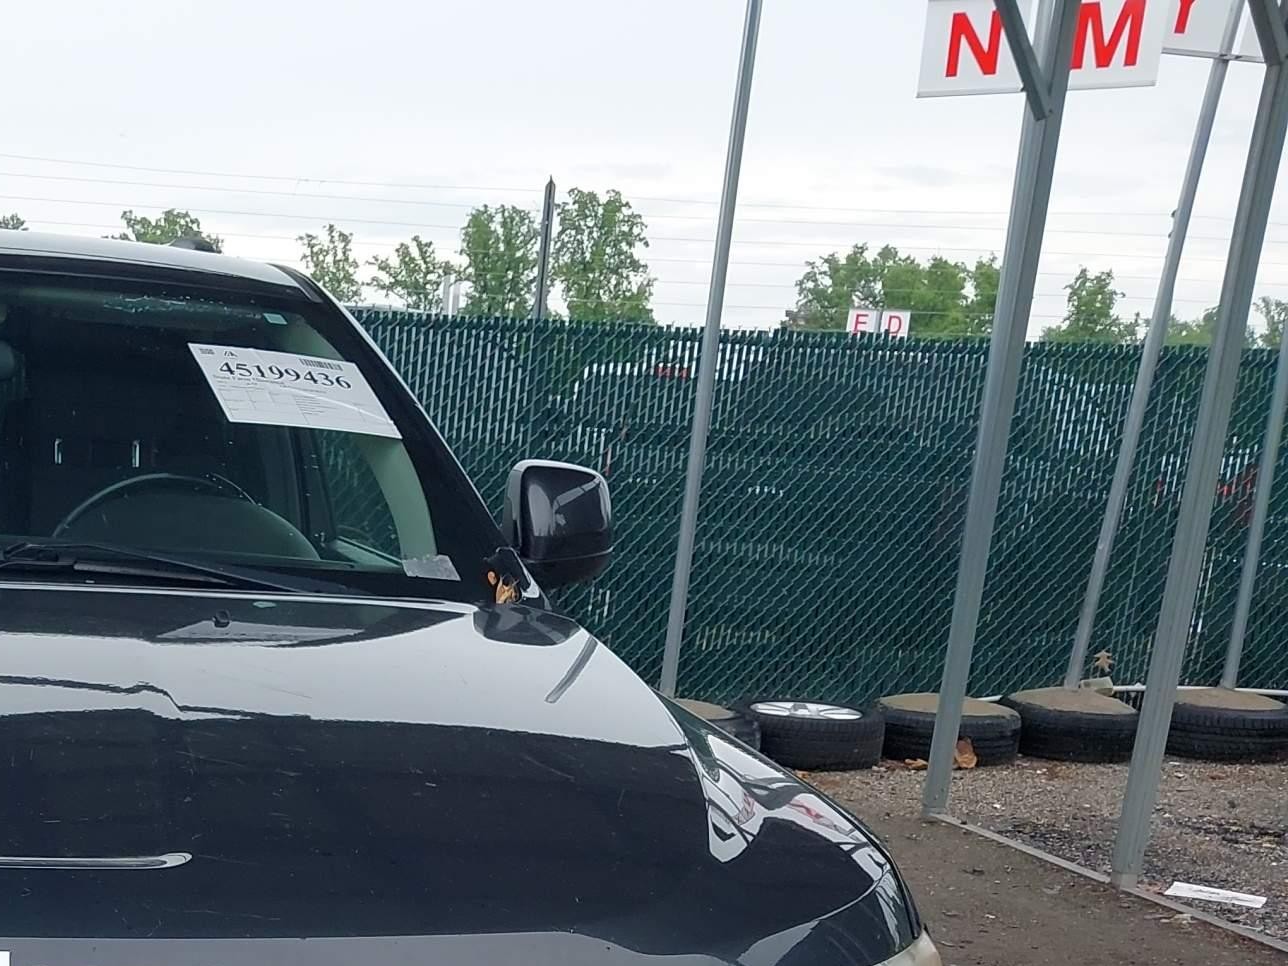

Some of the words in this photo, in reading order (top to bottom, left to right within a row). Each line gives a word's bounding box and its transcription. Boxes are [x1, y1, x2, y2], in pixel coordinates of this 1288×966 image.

[945, 11, 1002, 77] N
[1071, 0, 1146, 69] M
[888, 315, 902, 334] D
[219, 361, 352, 389] 45199436
